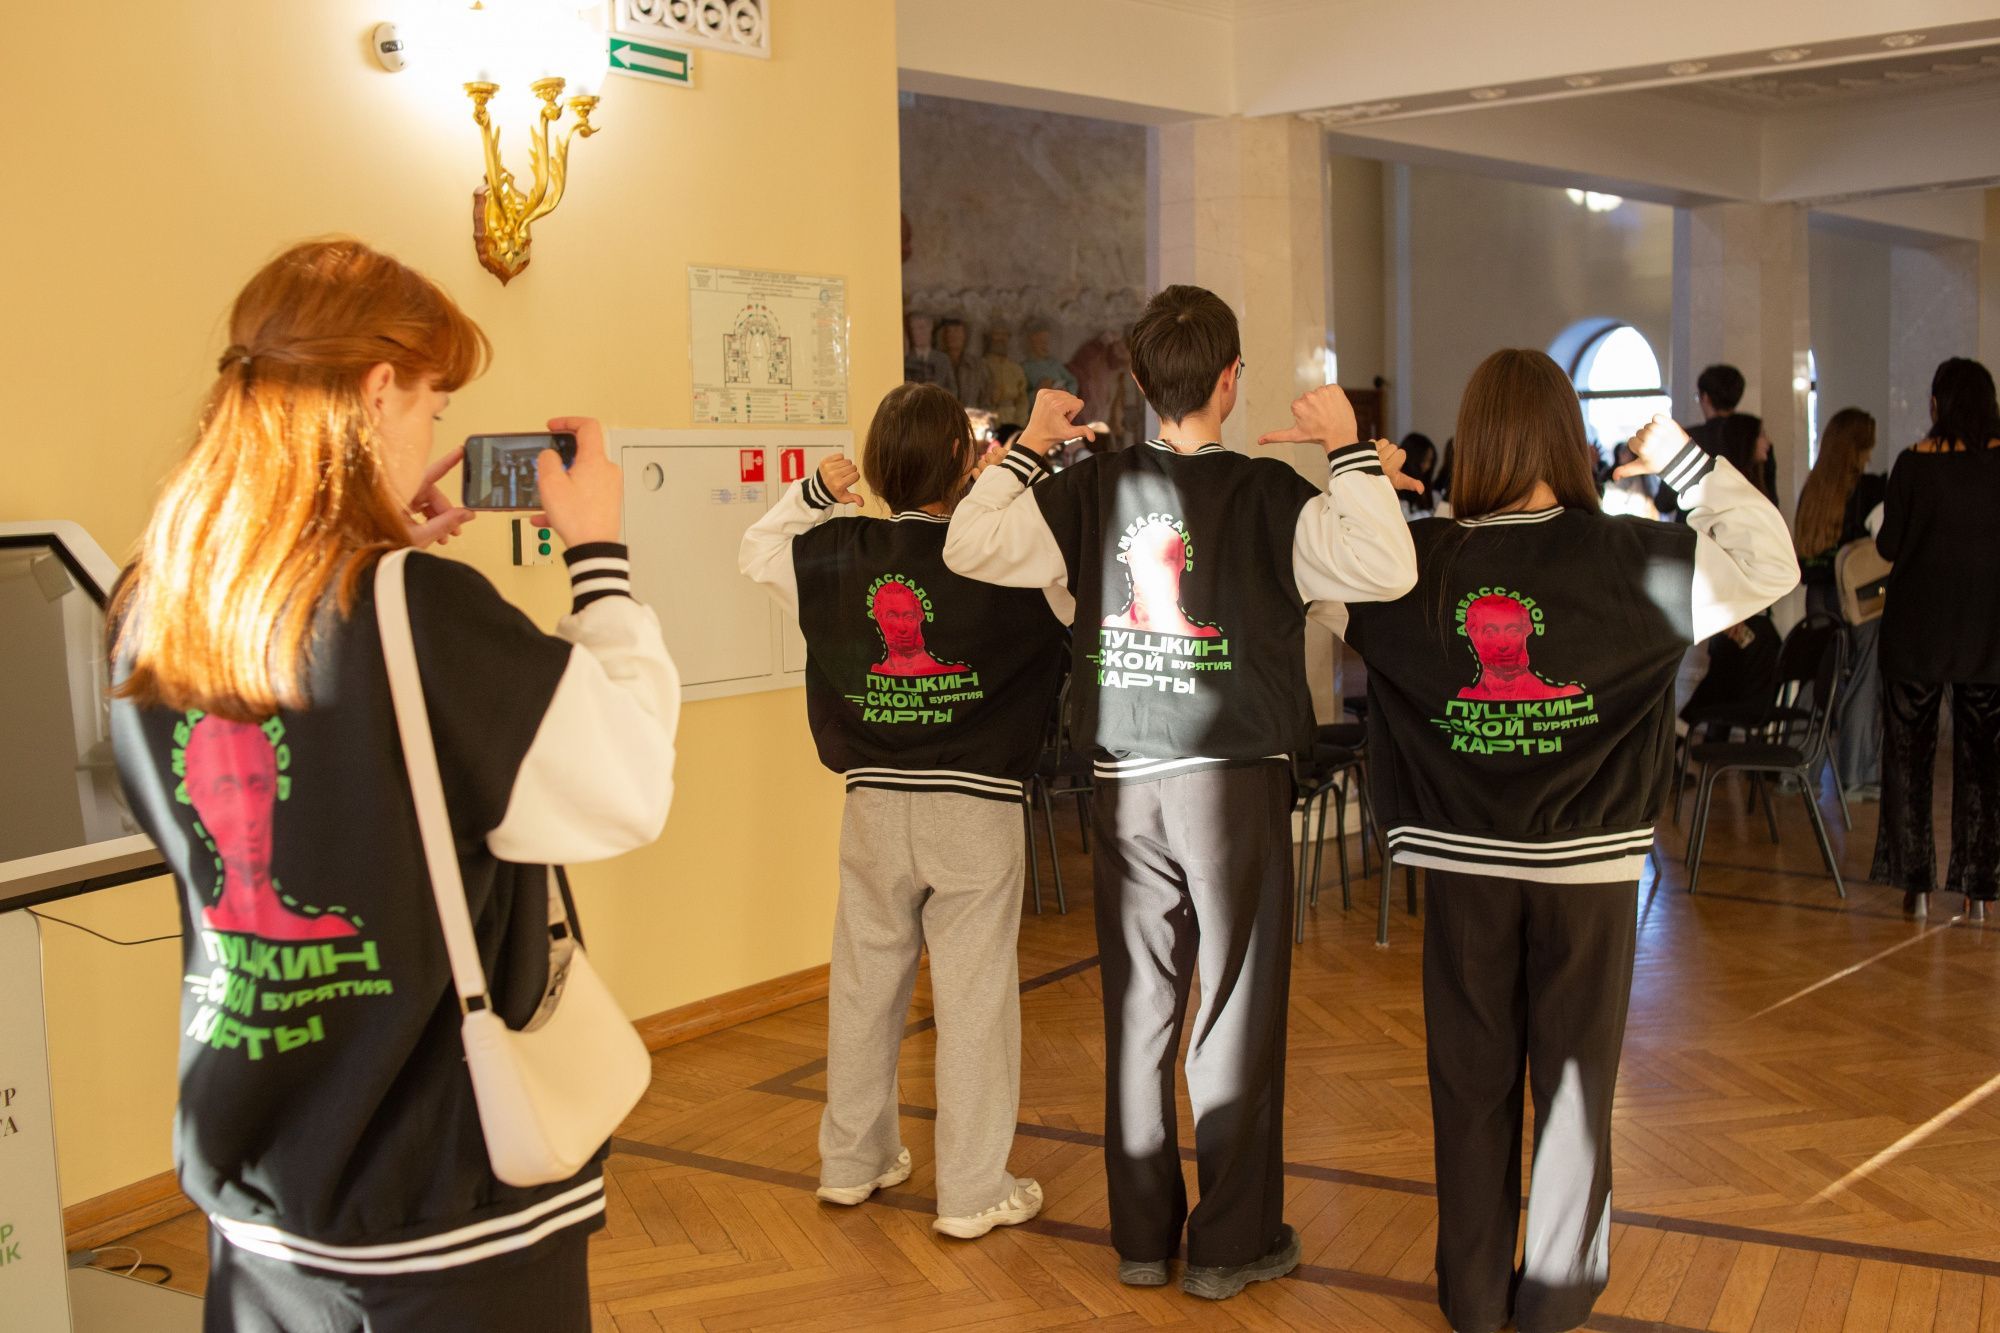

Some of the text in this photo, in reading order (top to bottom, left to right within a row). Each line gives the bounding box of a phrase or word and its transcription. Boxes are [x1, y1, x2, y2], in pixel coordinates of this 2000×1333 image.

[1116, 512, 1194, 573] АМБАССАДОР
[866, 573, 934, 623] АМБАССАДОР
[1455, 586, 1545, 637] АМБАССАДОР
[1099, 629, 1229, 657] ПУШКИН
[1099, 649, 1232, 672] СКОЙ БУРЯТИЯ
[866, 671, 979, 693] ПУШКИН
[1097, 670, 1196, 695] КАРТЫ
[866, 690, 984, 708] СКОЙ БУРЯТИЯ
[1445, 694, 1594, 719] ПУШКИН
[862, 708, 953, 724] КАРТЫ
[1450, 713, 1599, 737] СКОЙ БУРЯТИЯ
[171, 708, 292, 806] АМБАДОР
[1450, 734, 1562, 756] КАРТЫ
[201, 930, 381, 981] ПУШКИН
[207, 967, 393, 1017] СКОЙ БУРЯТИЯ
[186, 1004, 325, 1061] КАРТЫ
